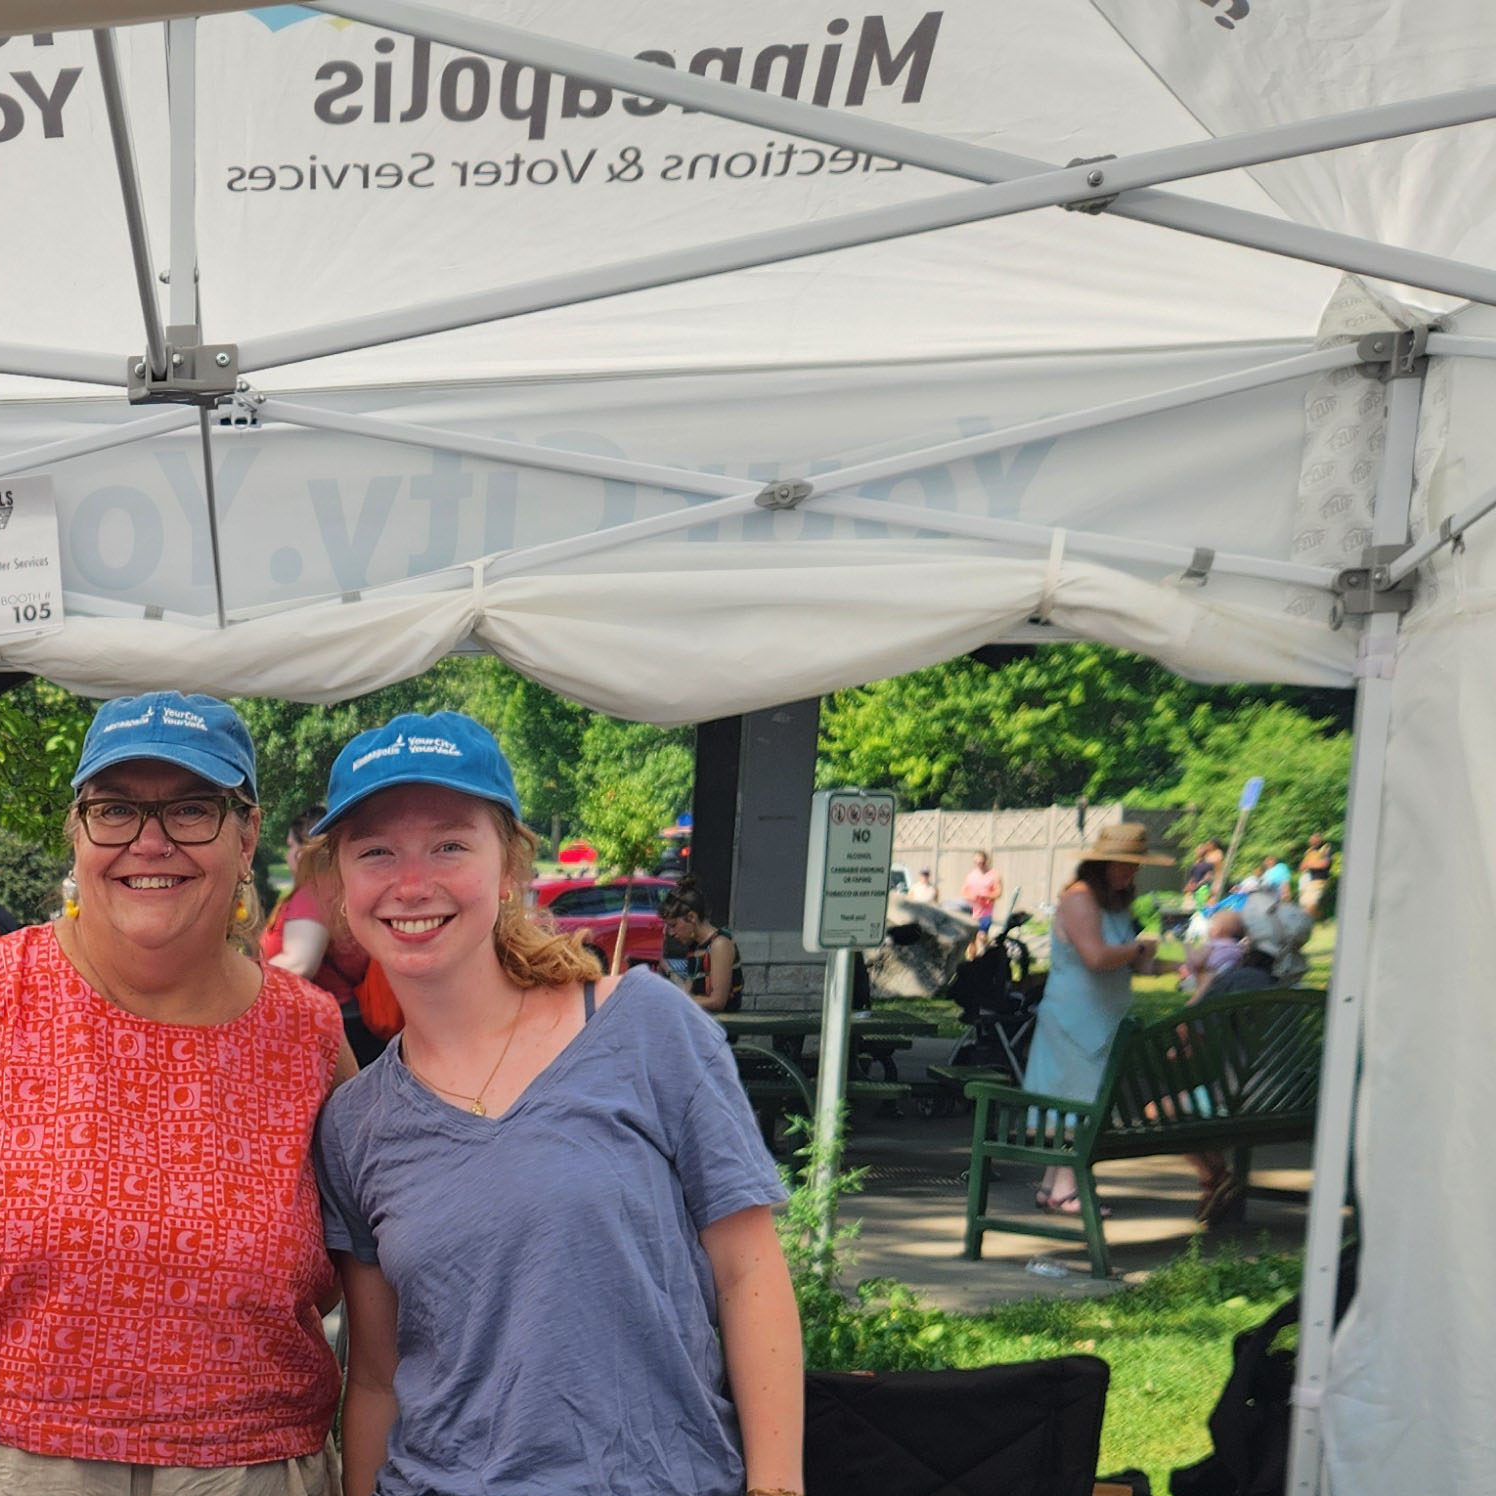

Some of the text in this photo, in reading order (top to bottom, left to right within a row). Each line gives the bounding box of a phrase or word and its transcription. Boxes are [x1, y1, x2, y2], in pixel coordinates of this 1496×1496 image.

[13, 556, 49, 570] Services
[0, 593, 42, 606] BOOTH
[13, 602, 52, 624] 105
[852, 828, 871, 843] NO
